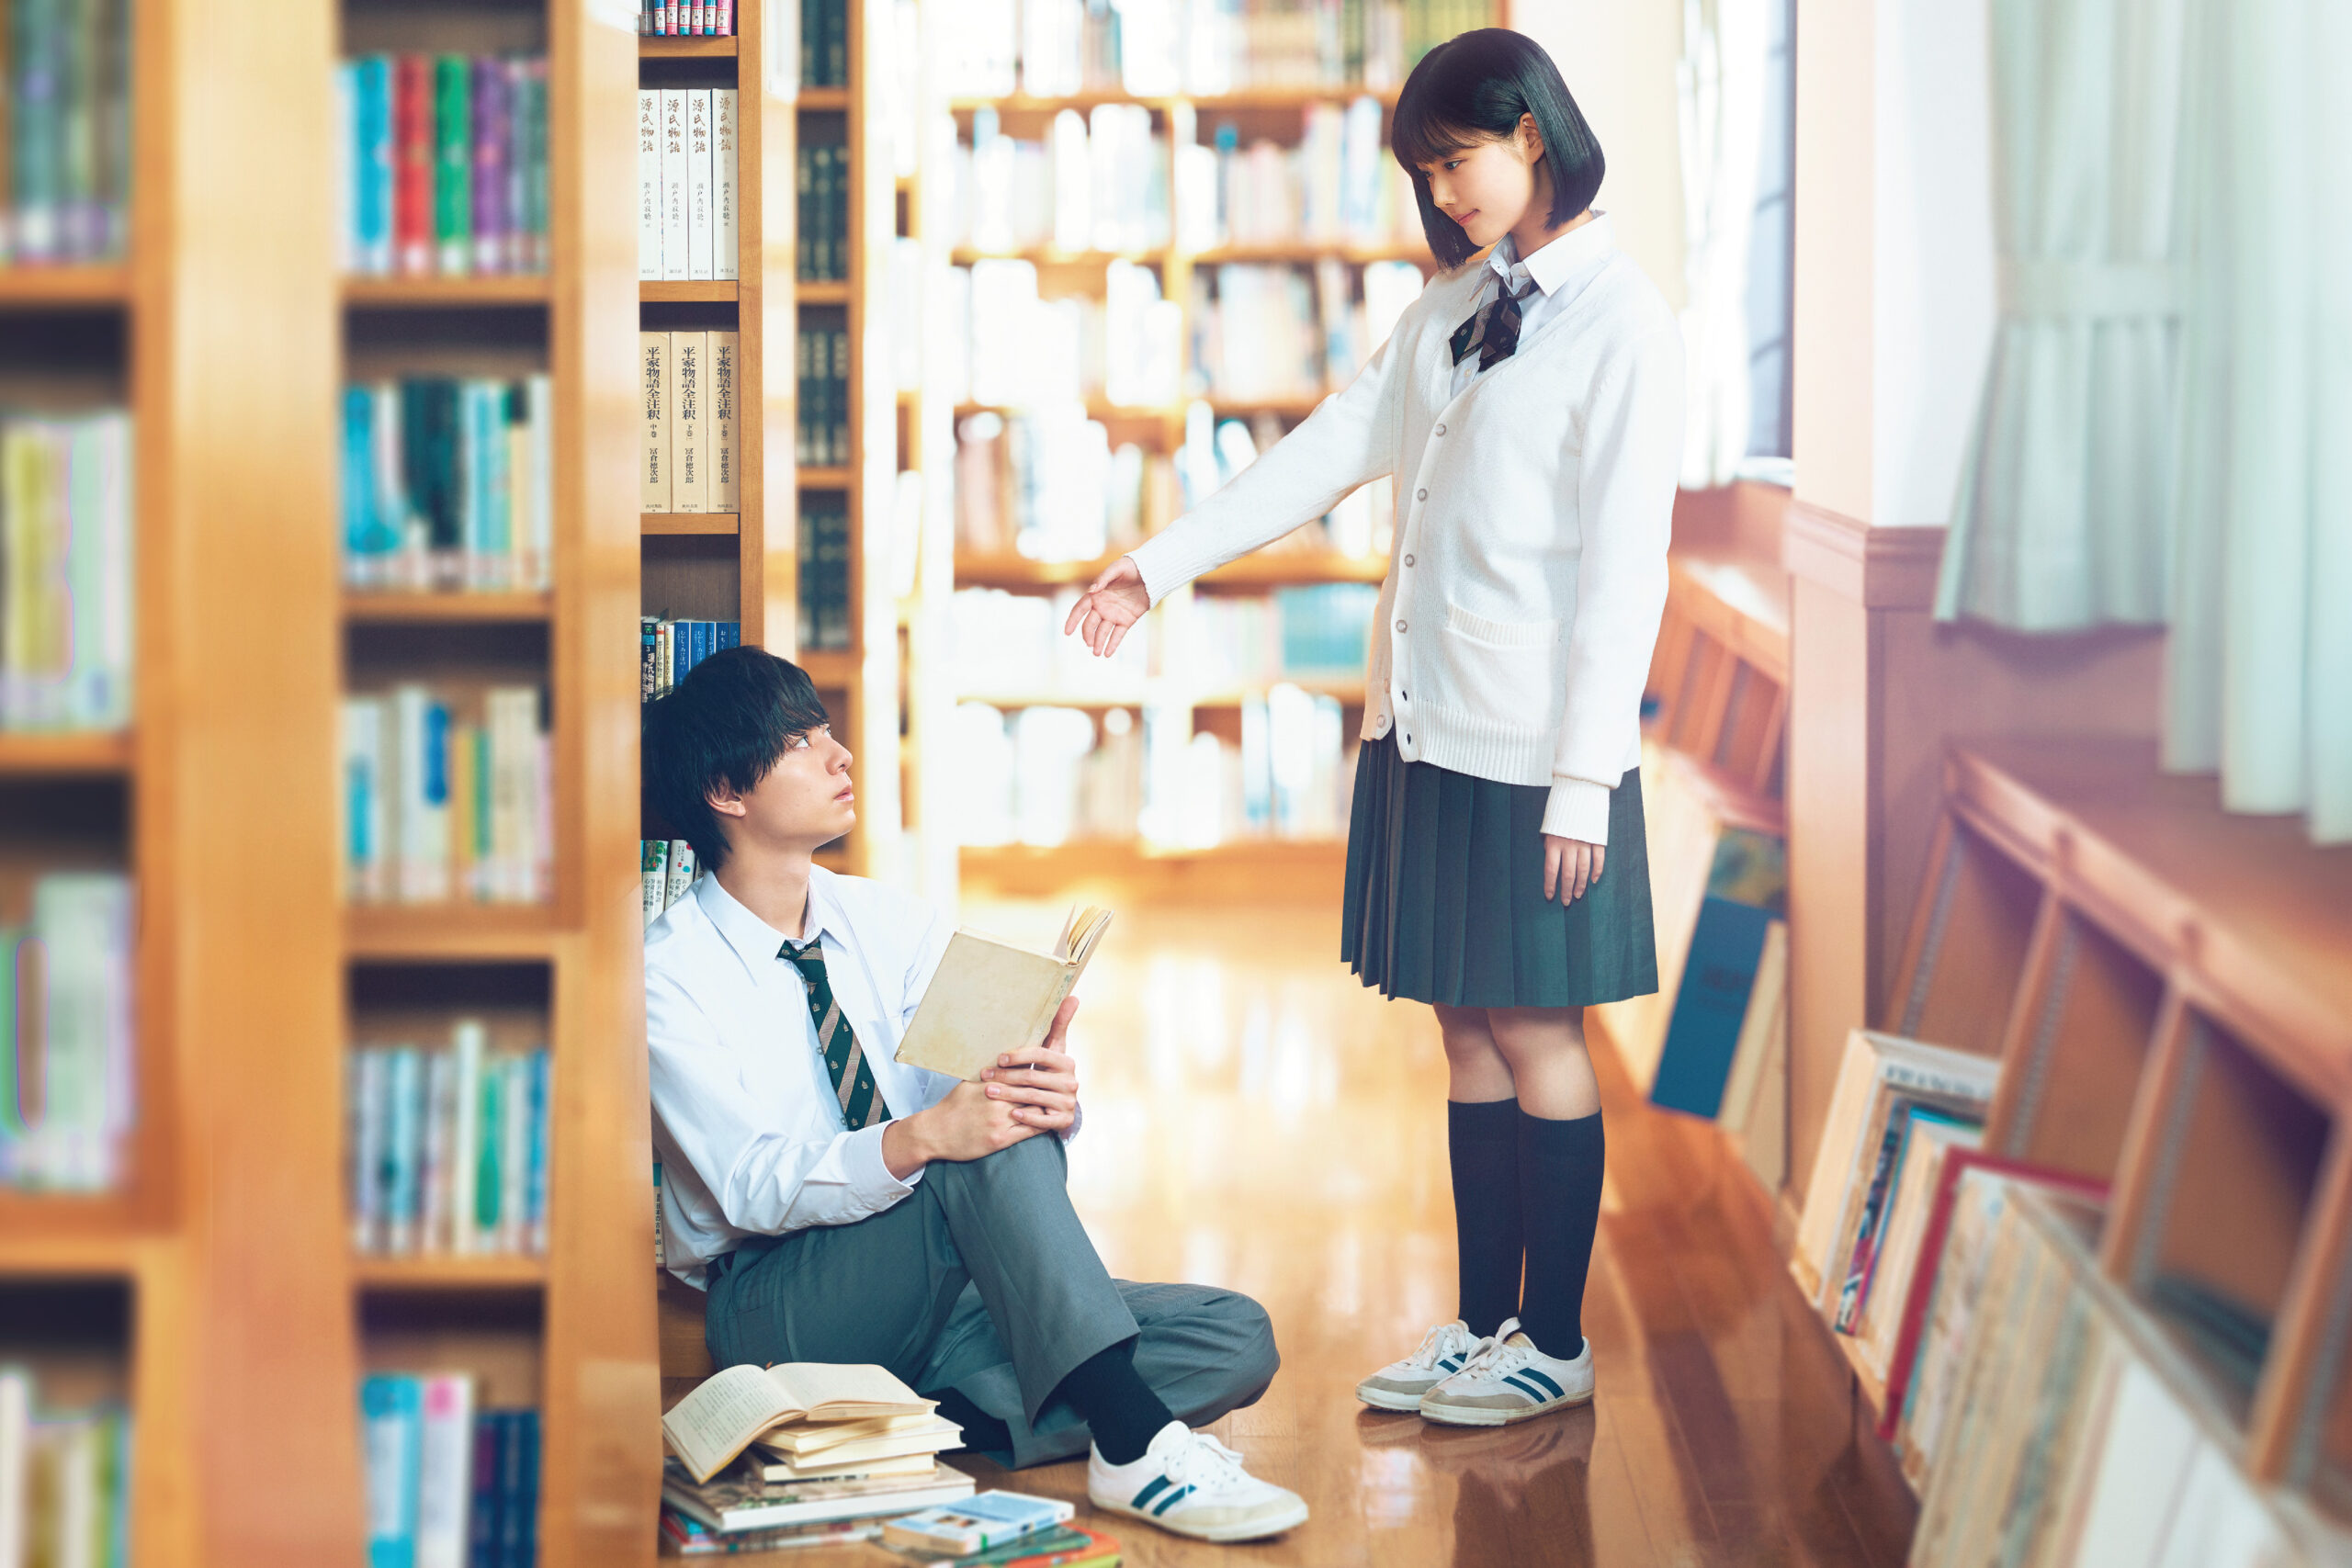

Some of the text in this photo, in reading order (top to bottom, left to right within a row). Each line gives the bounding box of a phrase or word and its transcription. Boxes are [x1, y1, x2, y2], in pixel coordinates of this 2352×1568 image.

[640, 97, 654, 153] 源氏物語
[667, 98, 681, 154] 源氏物語
[692, 98, 707, 154] 源氏物語
[718, 96, 732, 152] 源氏物語
[645, 345, 661, 420] 平家物語全注釈
[682, 345, 696, 420] 平家物語全注釈
[717, 345, 731, 420] 平家物語全注釈
[648, 652, 656, 694] 源氏物語
